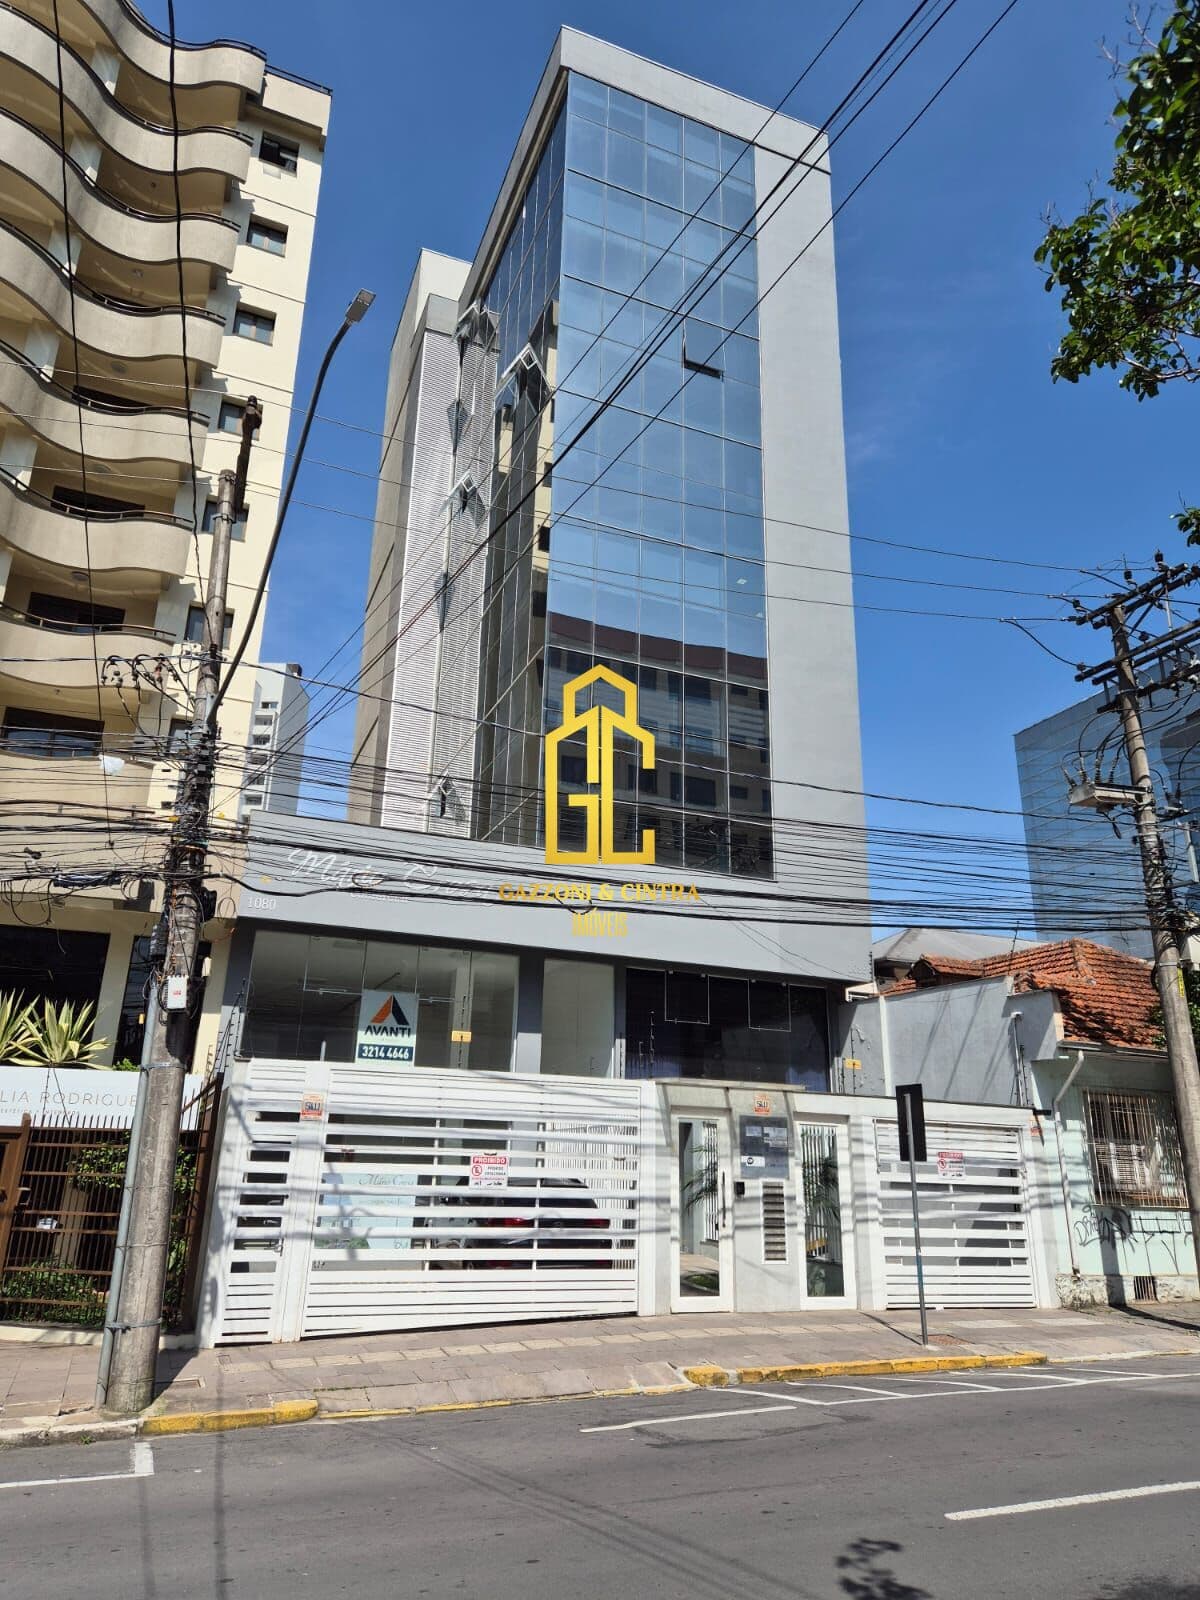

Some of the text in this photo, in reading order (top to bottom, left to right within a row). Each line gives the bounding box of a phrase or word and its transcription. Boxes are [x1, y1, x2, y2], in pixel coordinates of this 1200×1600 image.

[247, 896, 277, 910] 1080
[365, 1025, 411, 1038] AVANTI
[362, 1046, 409, 1060] 3214 4646
